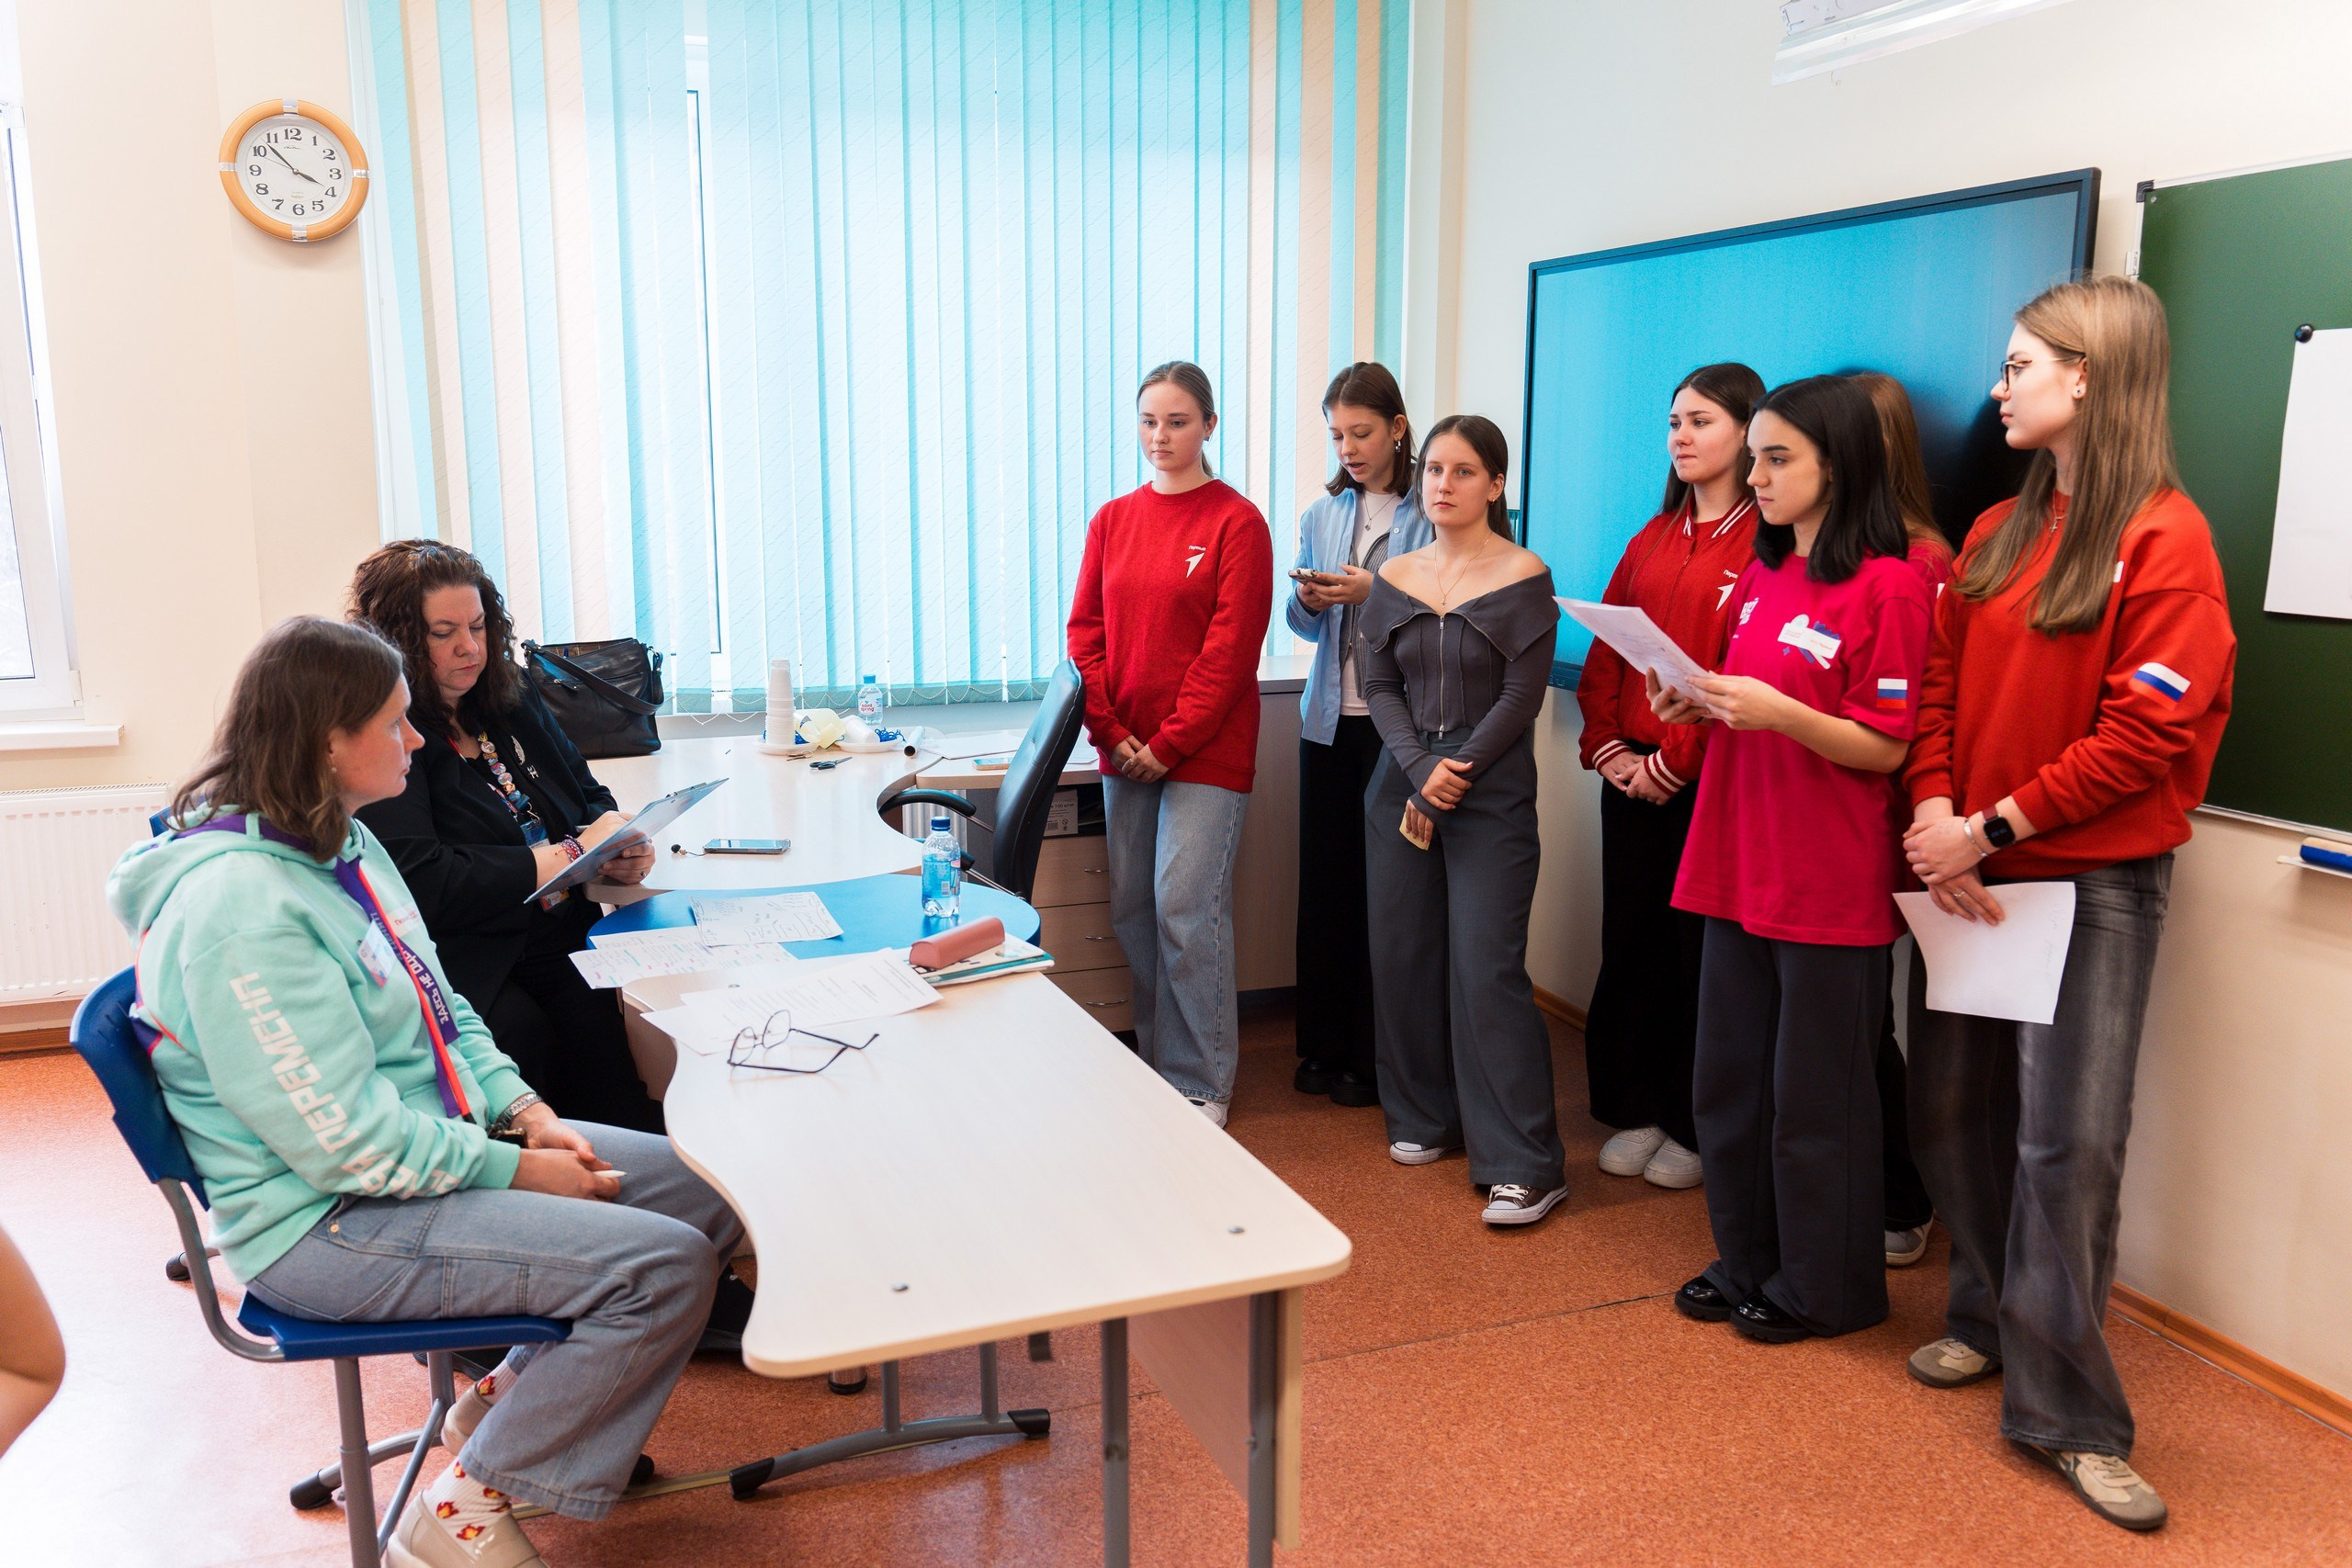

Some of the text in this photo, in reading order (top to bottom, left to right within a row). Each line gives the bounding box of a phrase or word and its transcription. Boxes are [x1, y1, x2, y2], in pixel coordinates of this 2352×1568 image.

[266, 132, 278, 143] 11
[284, 128, 302, 141] 12
[312, 135, 318, 146] 1
[253, 145, 267, 157] 10
[322, 148, 336, 161] 2
[249, 164, 262, 176] 9
[329, 168, 342, 180] 3
[255, 183, 269, 196] 8
[324, 186, 337, 197] 4
[271, 198, 285, 210] 7
[292, 203, 305, 216] 6
[311, 199, 324, 212] 5
[419, 972, 435, 988] НЕ
[432, 987, 449, 1024] ЗДЕСЬ
[229, 971, 360, 1155] ПЕРЕМЕНА
